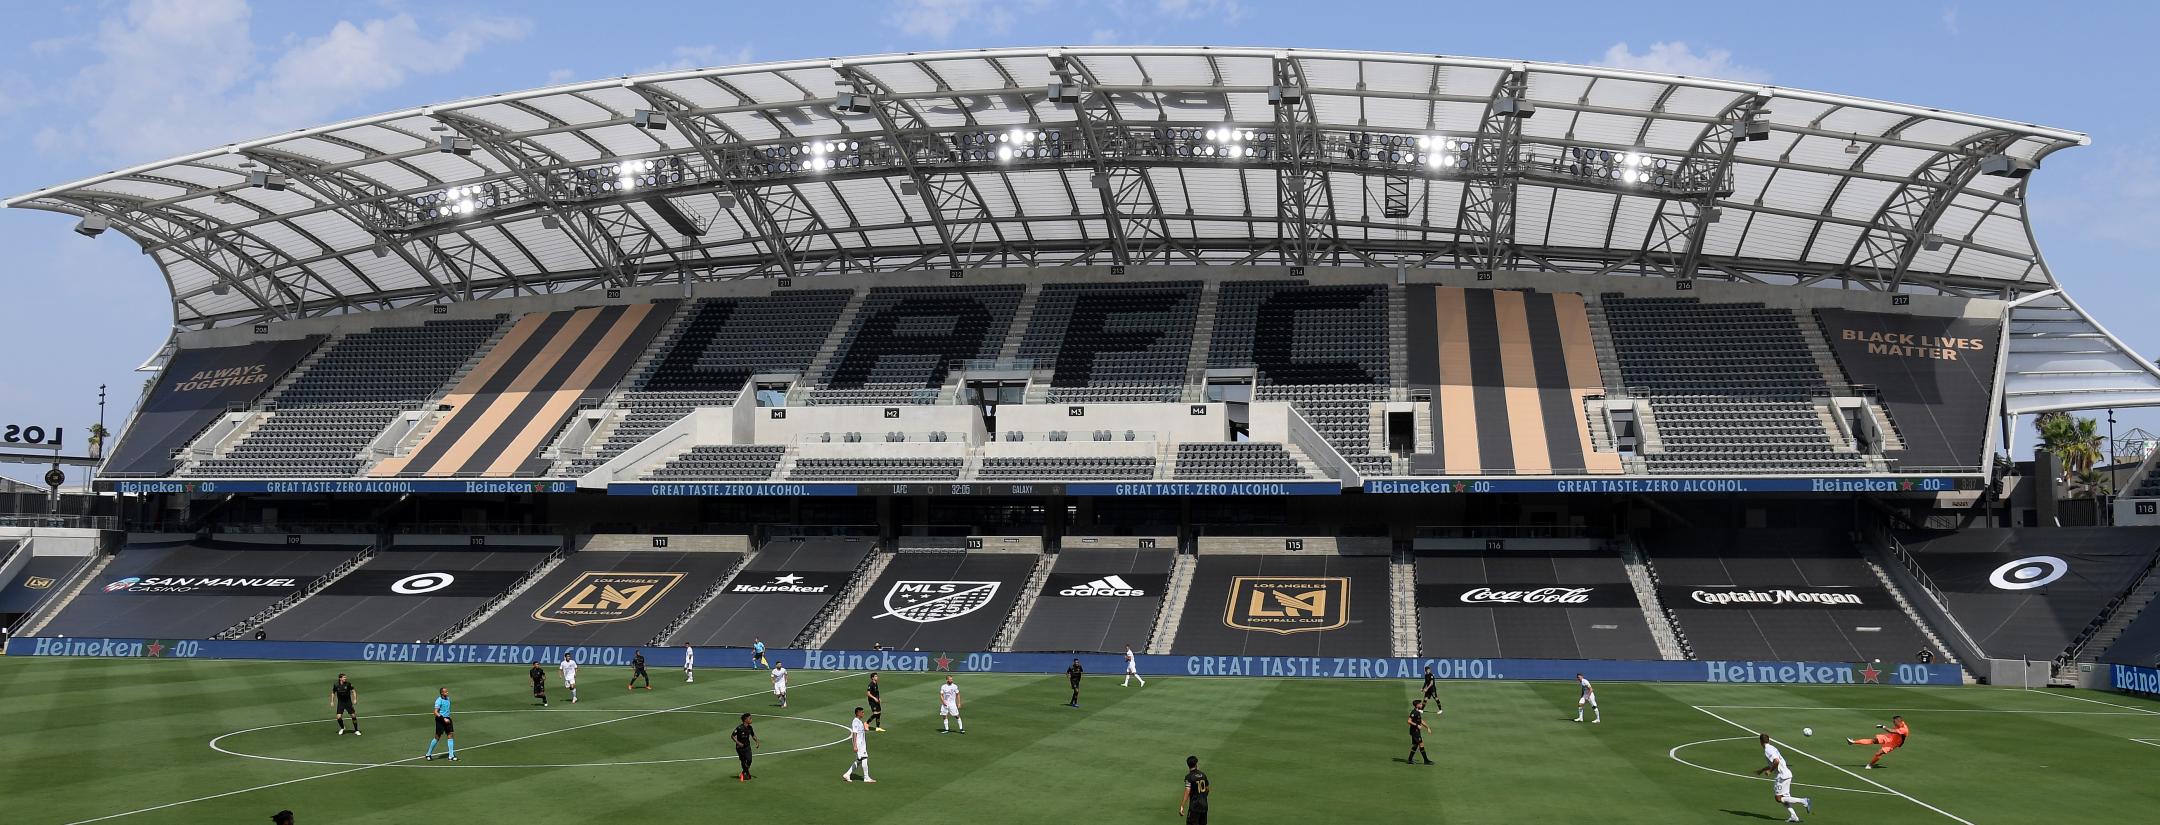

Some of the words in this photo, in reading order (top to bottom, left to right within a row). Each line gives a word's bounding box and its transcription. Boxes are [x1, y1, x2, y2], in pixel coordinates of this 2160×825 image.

[1842, 329, 1914, 344] BLACK
[1921, 335, 1984, 350] LIVES
[1867, 342, 1957, 361] MATTER
[191, 364, 266, 381] ALWAYS
[174, 373, 268, 392] TOGETHER
[886, 410, 897, 418] M2
[1071, 408, 1082, 416] M3
[1192, 407, 1204, 415] M4
[120, 481, 184, 493] Heineken
[267, 481, 299, 493] GREAT
[365, 481, 416, 493] ALCOHOL.
[466, 481, 532, 493] Heineken
[652, 484, 684, 496] GREAT
[756, 484, 810, 496] ALCOHOL.
[893, 484, 908, 494] LAFC
[951, 484, 971, 495] 32:05
[1012, 485, 1033, 494] GALAXY
[1115, 484, 1152, 495] GREAT
[1231, 484, 1290, 495] ALCOHOL.
[1371, 481, 1450, 493] Heineken
[1557, 480, 1597, 492] GREAT
[1683, 480, 1747, 492] ALCOHOL.
[1812, 479, 1898, 492] Heineken
[2138, 505, 2153, 513] 118
[654, 538, 666, 547] 111
[968, 540, 981, 548] 113
[1288, 541, 1301, 549] 115
[1488, 541, 1500, 549] 116
[139, 577, 196, 586] SAN
[194, 578, 296, 587] MANUEL
[732, 584, 826, 593] Heineken
[899, 584, 957, 594] MLS
[1060, 586, 1145, 597] adidas
[1691, 589, 1774, 604] Captain
[1768, 589, 1864, 604] Morgan
[32, 637, 142, 657] Heineken
[363, 643, 420, 662] GREAT
[803, 650, 929, 671] Heineken
[1187, 655, 1253, 675] GREAT
[1705, 660, 1853, 684] Heineken
[2115, 664, 2160, 694] Heine
[1196, 779, 1206, 793] 10
